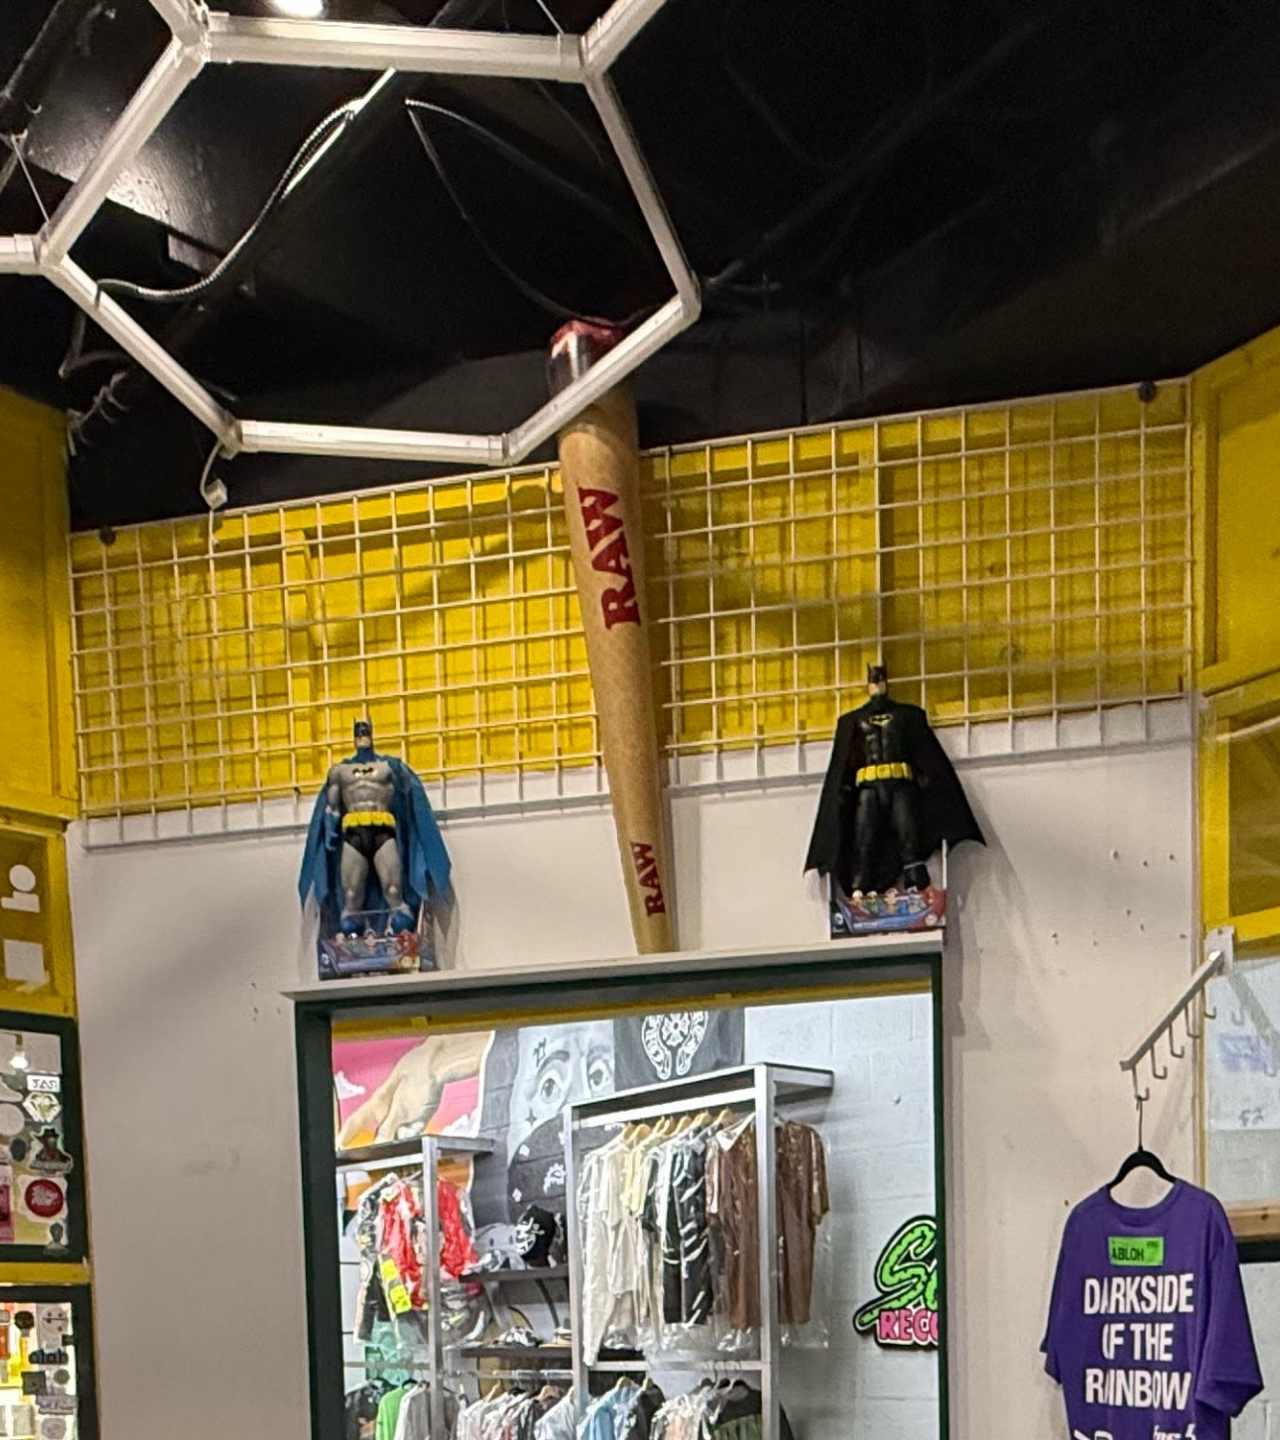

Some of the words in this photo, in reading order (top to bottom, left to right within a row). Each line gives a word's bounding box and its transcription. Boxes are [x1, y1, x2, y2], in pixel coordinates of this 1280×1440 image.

[577, 486, 642, 630] RAW
[630, 841, 665, 917] RAW
[1129, 1322, 1175, 1362] THE
